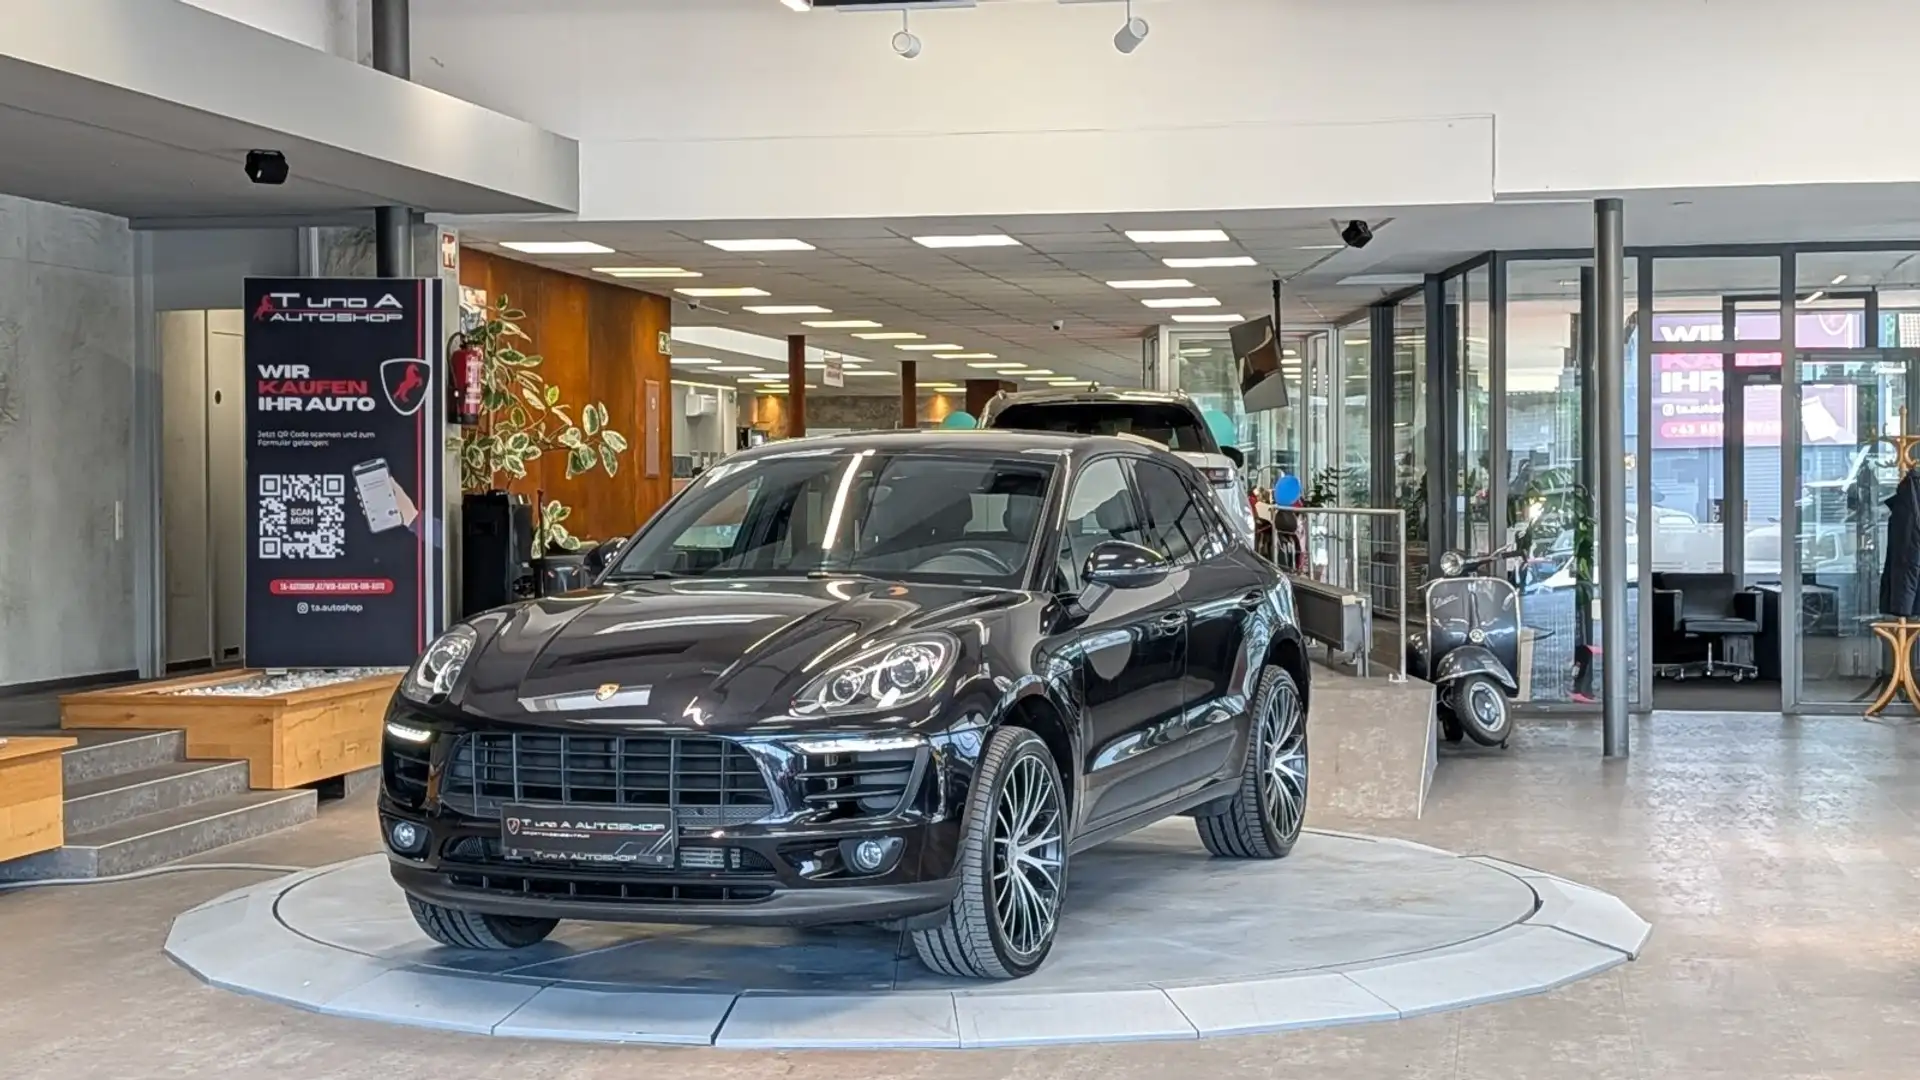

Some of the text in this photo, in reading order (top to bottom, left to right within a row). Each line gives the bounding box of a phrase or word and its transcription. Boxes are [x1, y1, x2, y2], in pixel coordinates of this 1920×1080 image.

[270, 293, 300, 308] T
[374, 293, 403, 309] A
[270, 313, 403, 322] AUTOSHOP
[257, 364, 310, 379] WIR
[258, 380, 368, 395] KAUFEN
[258, 396, 376, 411] IHR AUTO
[290, 430, 309, 439] Code
[310, 431, 342, 439] scannen
[343, 430, 357, 439] und
[290, 508, 314, 516] SCAN
[290, 517, 314, 525] MICH
[311, 603, 364, 613] ta.autoshop
[521, 818, 532, 827] T
[560, 820, 572, 829] A
[575, 822, 666, 832] AUTOSHOP
[570, 852, 637, 862] AUTOSHOP
